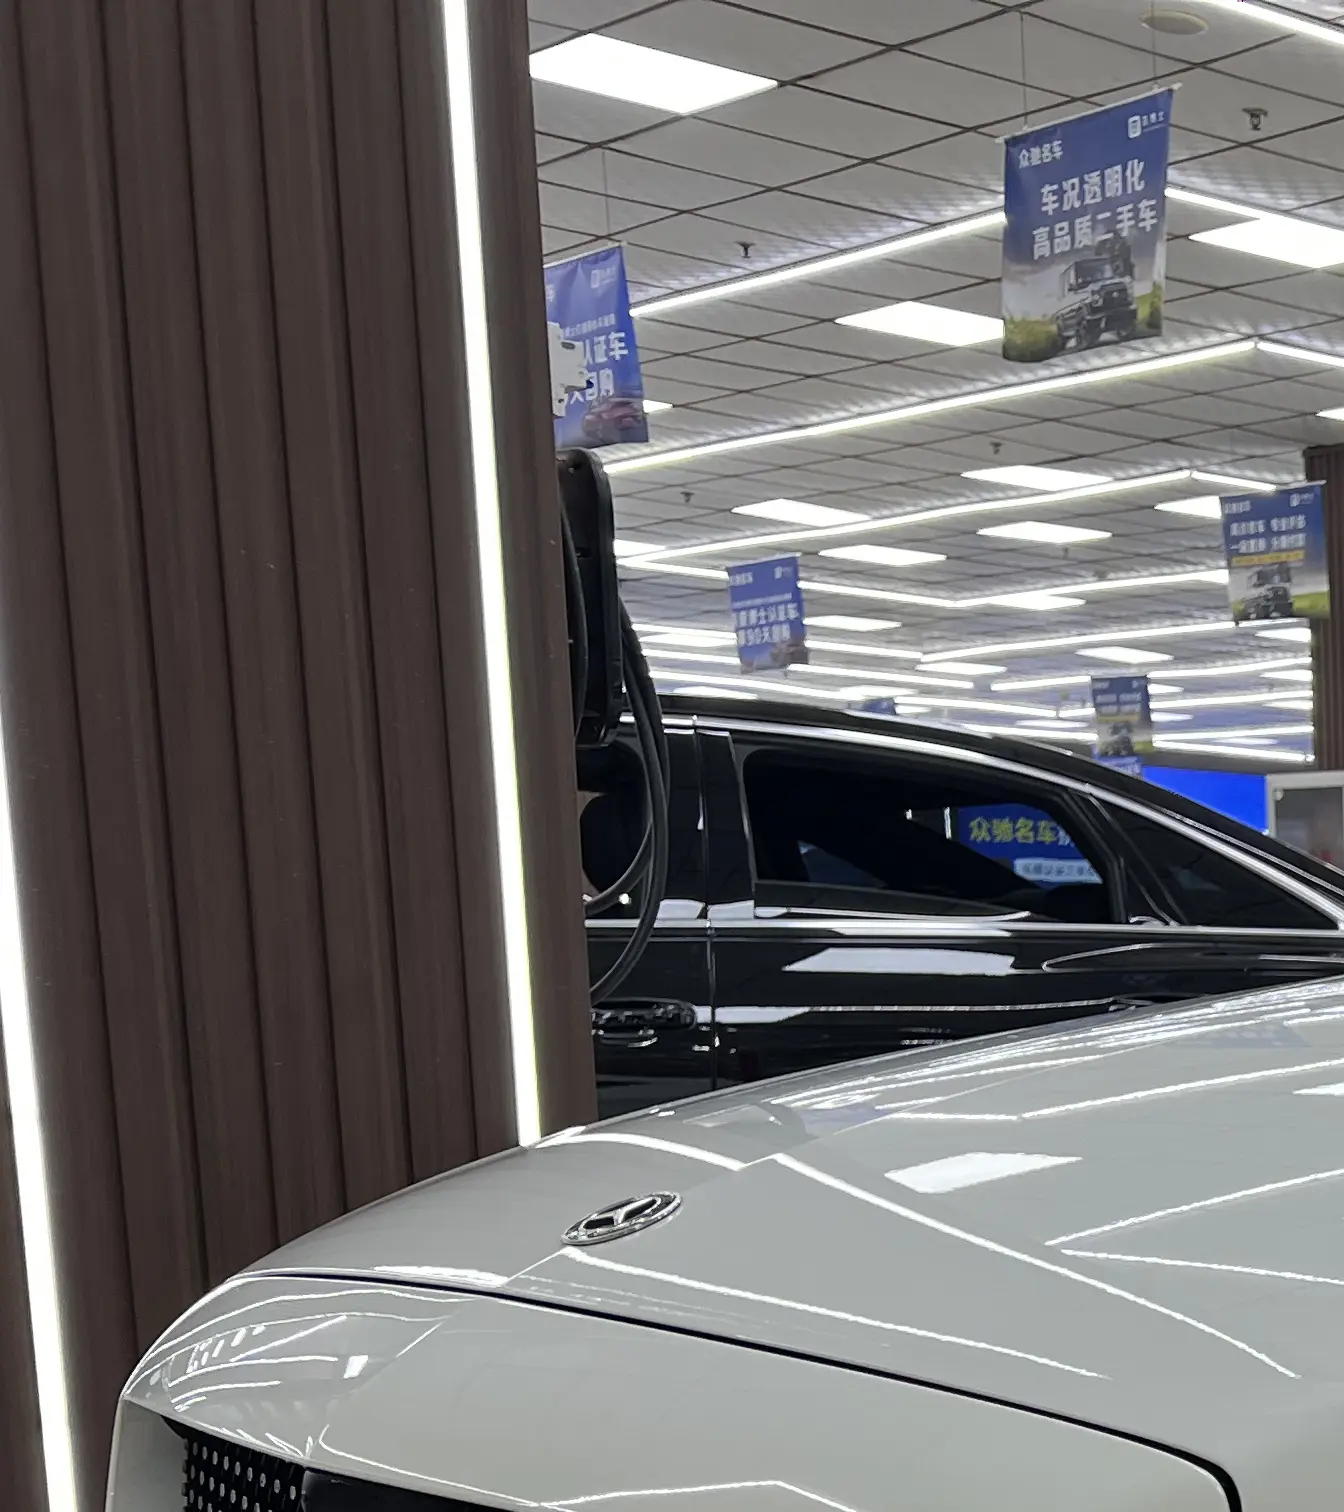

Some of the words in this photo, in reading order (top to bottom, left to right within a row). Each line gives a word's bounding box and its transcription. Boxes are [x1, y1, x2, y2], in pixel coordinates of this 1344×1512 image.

[1040, 158, 1146, 216] 车况透明化
[1032, 199, 1158, 260] 高品质二手车
